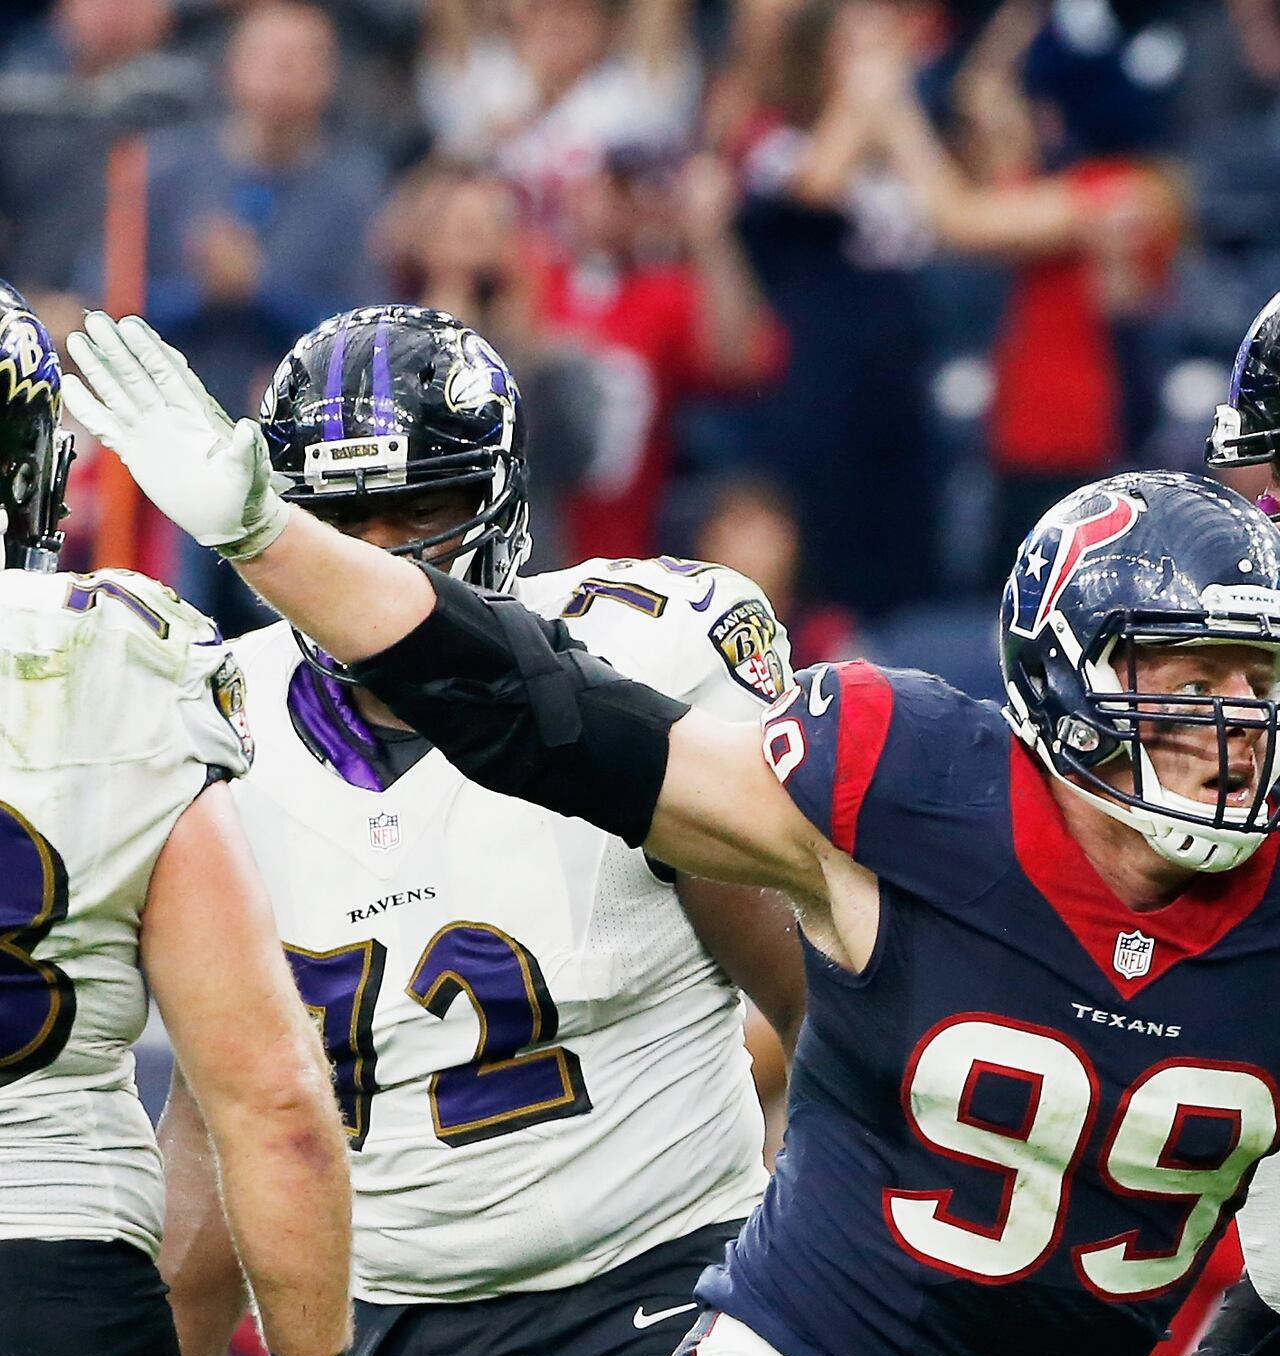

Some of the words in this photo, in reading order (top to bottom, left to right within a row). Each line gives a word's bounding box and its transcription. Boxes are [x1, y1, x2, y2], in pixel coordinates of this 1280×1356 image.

[330, 443, 379, 460] RAVENS
[1230, 594, 1276, 604] TEXANS
[730, 626, 756, 663] B
[372, 828, 398, 845] NFL
[346, 886, 437, 924] RAVENS
[1120, 950, 1145, 970] NFL
[1071, 1002, 1182, 1038] TEXANS
[284, 920, 594, 1150] 72
